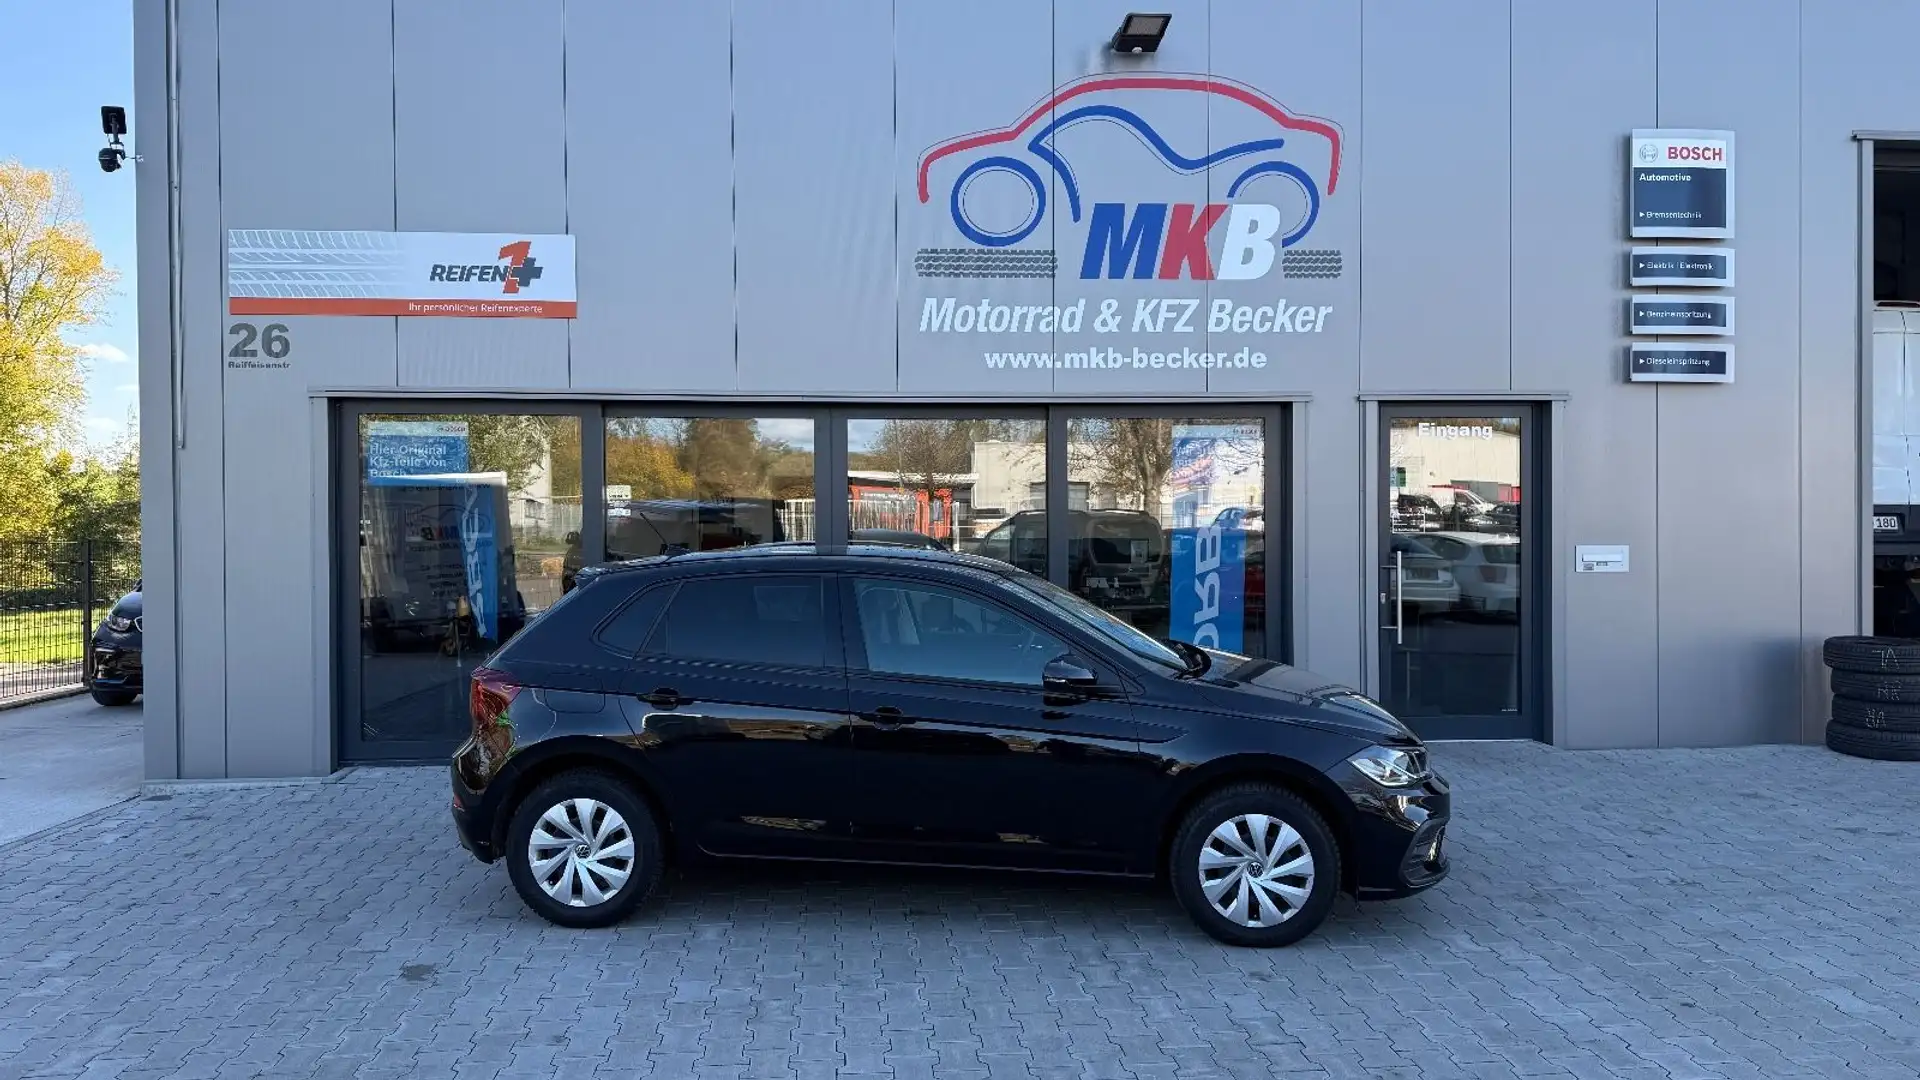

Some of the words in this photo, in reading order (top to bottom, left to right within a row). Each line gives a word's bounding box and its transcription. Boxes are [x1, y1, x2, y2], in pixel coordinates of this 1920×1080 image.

[1667, 146, 1722, 161] BOSCH
[1639, 173, 1692, 182] Automotive
[1079, 203, 1281, 280] MKB
[409, 302, 421, 311] Ihr
[919, 297, 1087, 333] Motorrad
[1093, 299, 1122, 333] &
[1131, 299, 1200, 333] KFZ
[1207, 299, 1333, 333] Becker
[228, 323, 291, 358] 26
[984, 347, 1268, 369] www.mkb-becker.de
[1417, 423, 1493, 440] Eingang
[369, 444, 396, 455] Hier
[399, 444, 447, 458] Original
[425, 459, 447, 467] von
[1876, 518, 1896, 528] 180
